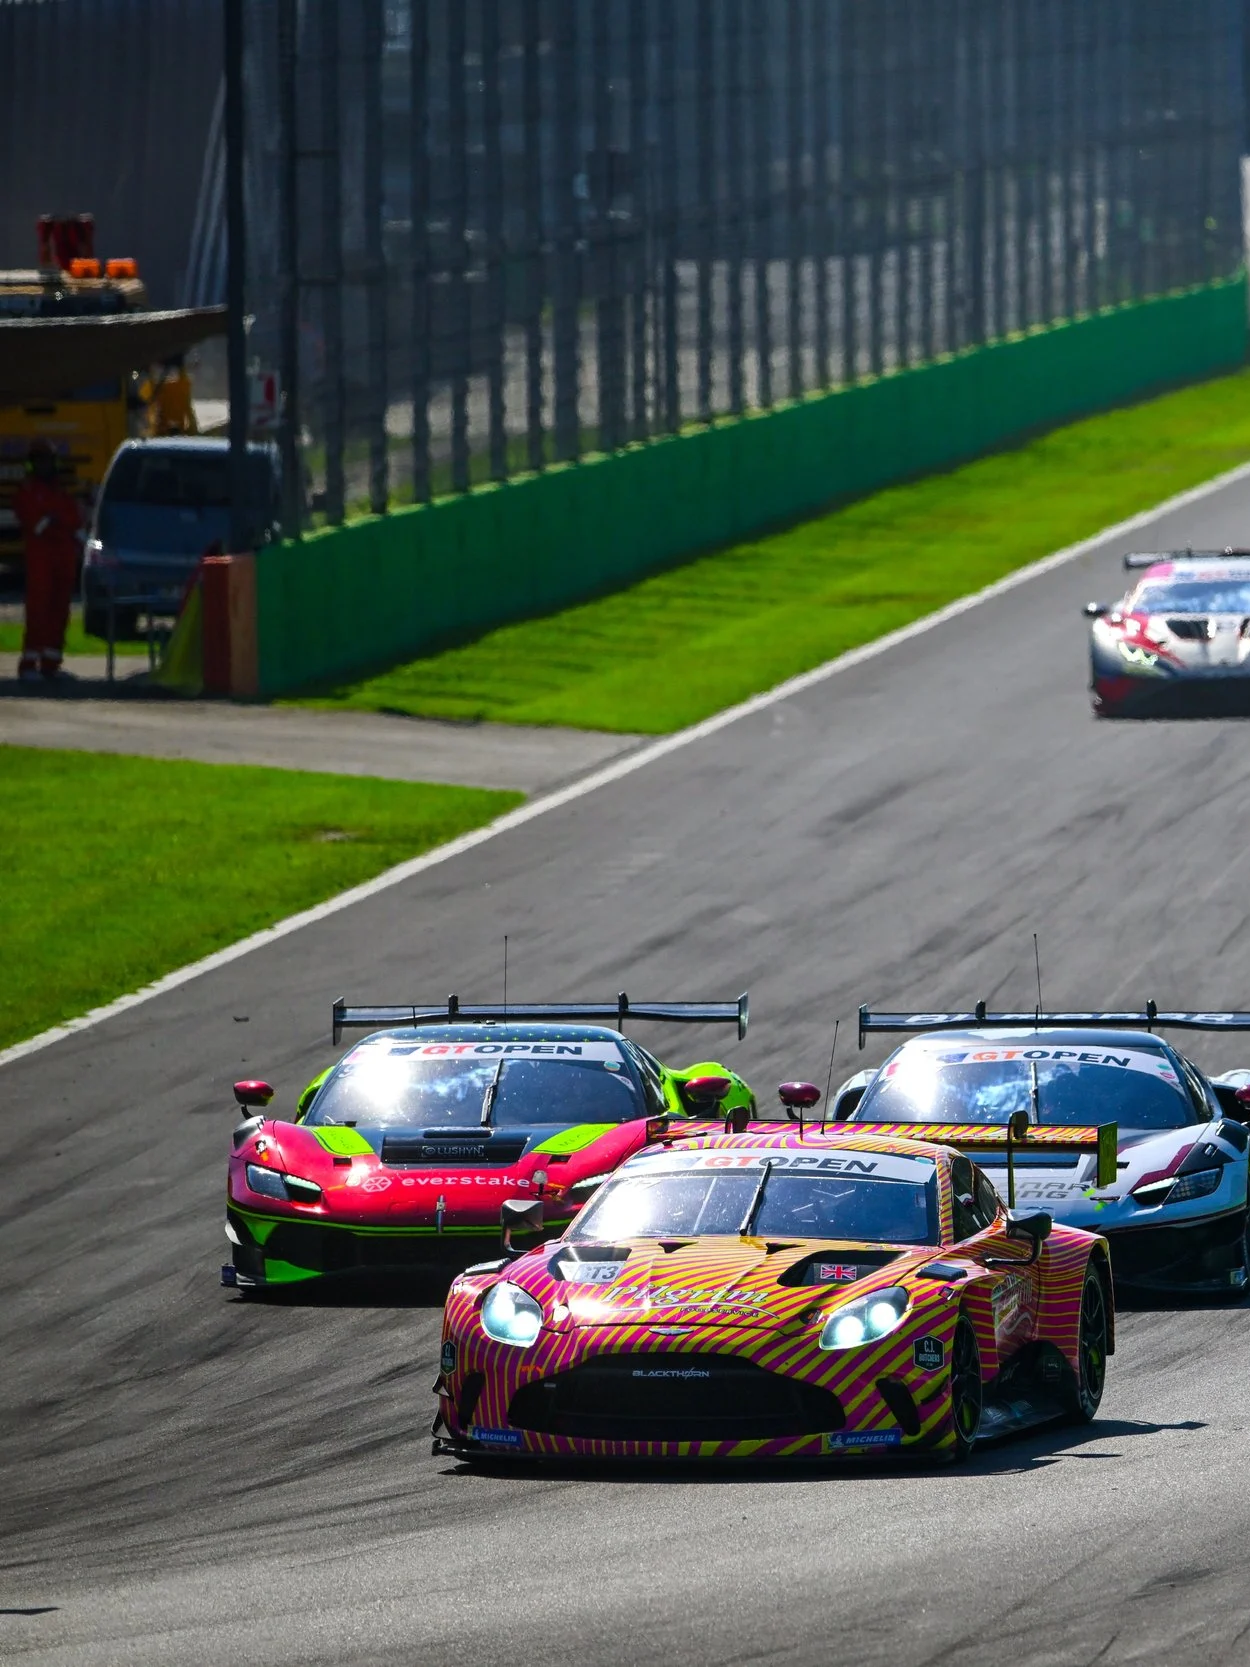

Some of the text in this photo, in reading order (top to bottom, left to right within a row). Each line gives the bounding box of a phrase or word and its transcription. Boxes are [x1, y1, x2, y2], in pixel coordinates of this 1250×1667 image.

[437, 1146, 481, 1155] LUSHYN
[402, 1175, 530, 1188] everstake
[601, 1285, 769, 1305] Pilgrim
[632, 1369, 710, 1378] BLACKTHORN
[480, 1433, 518, 1442] MICHELIN
[846, 1434, 896, 1444] MICHELIN
